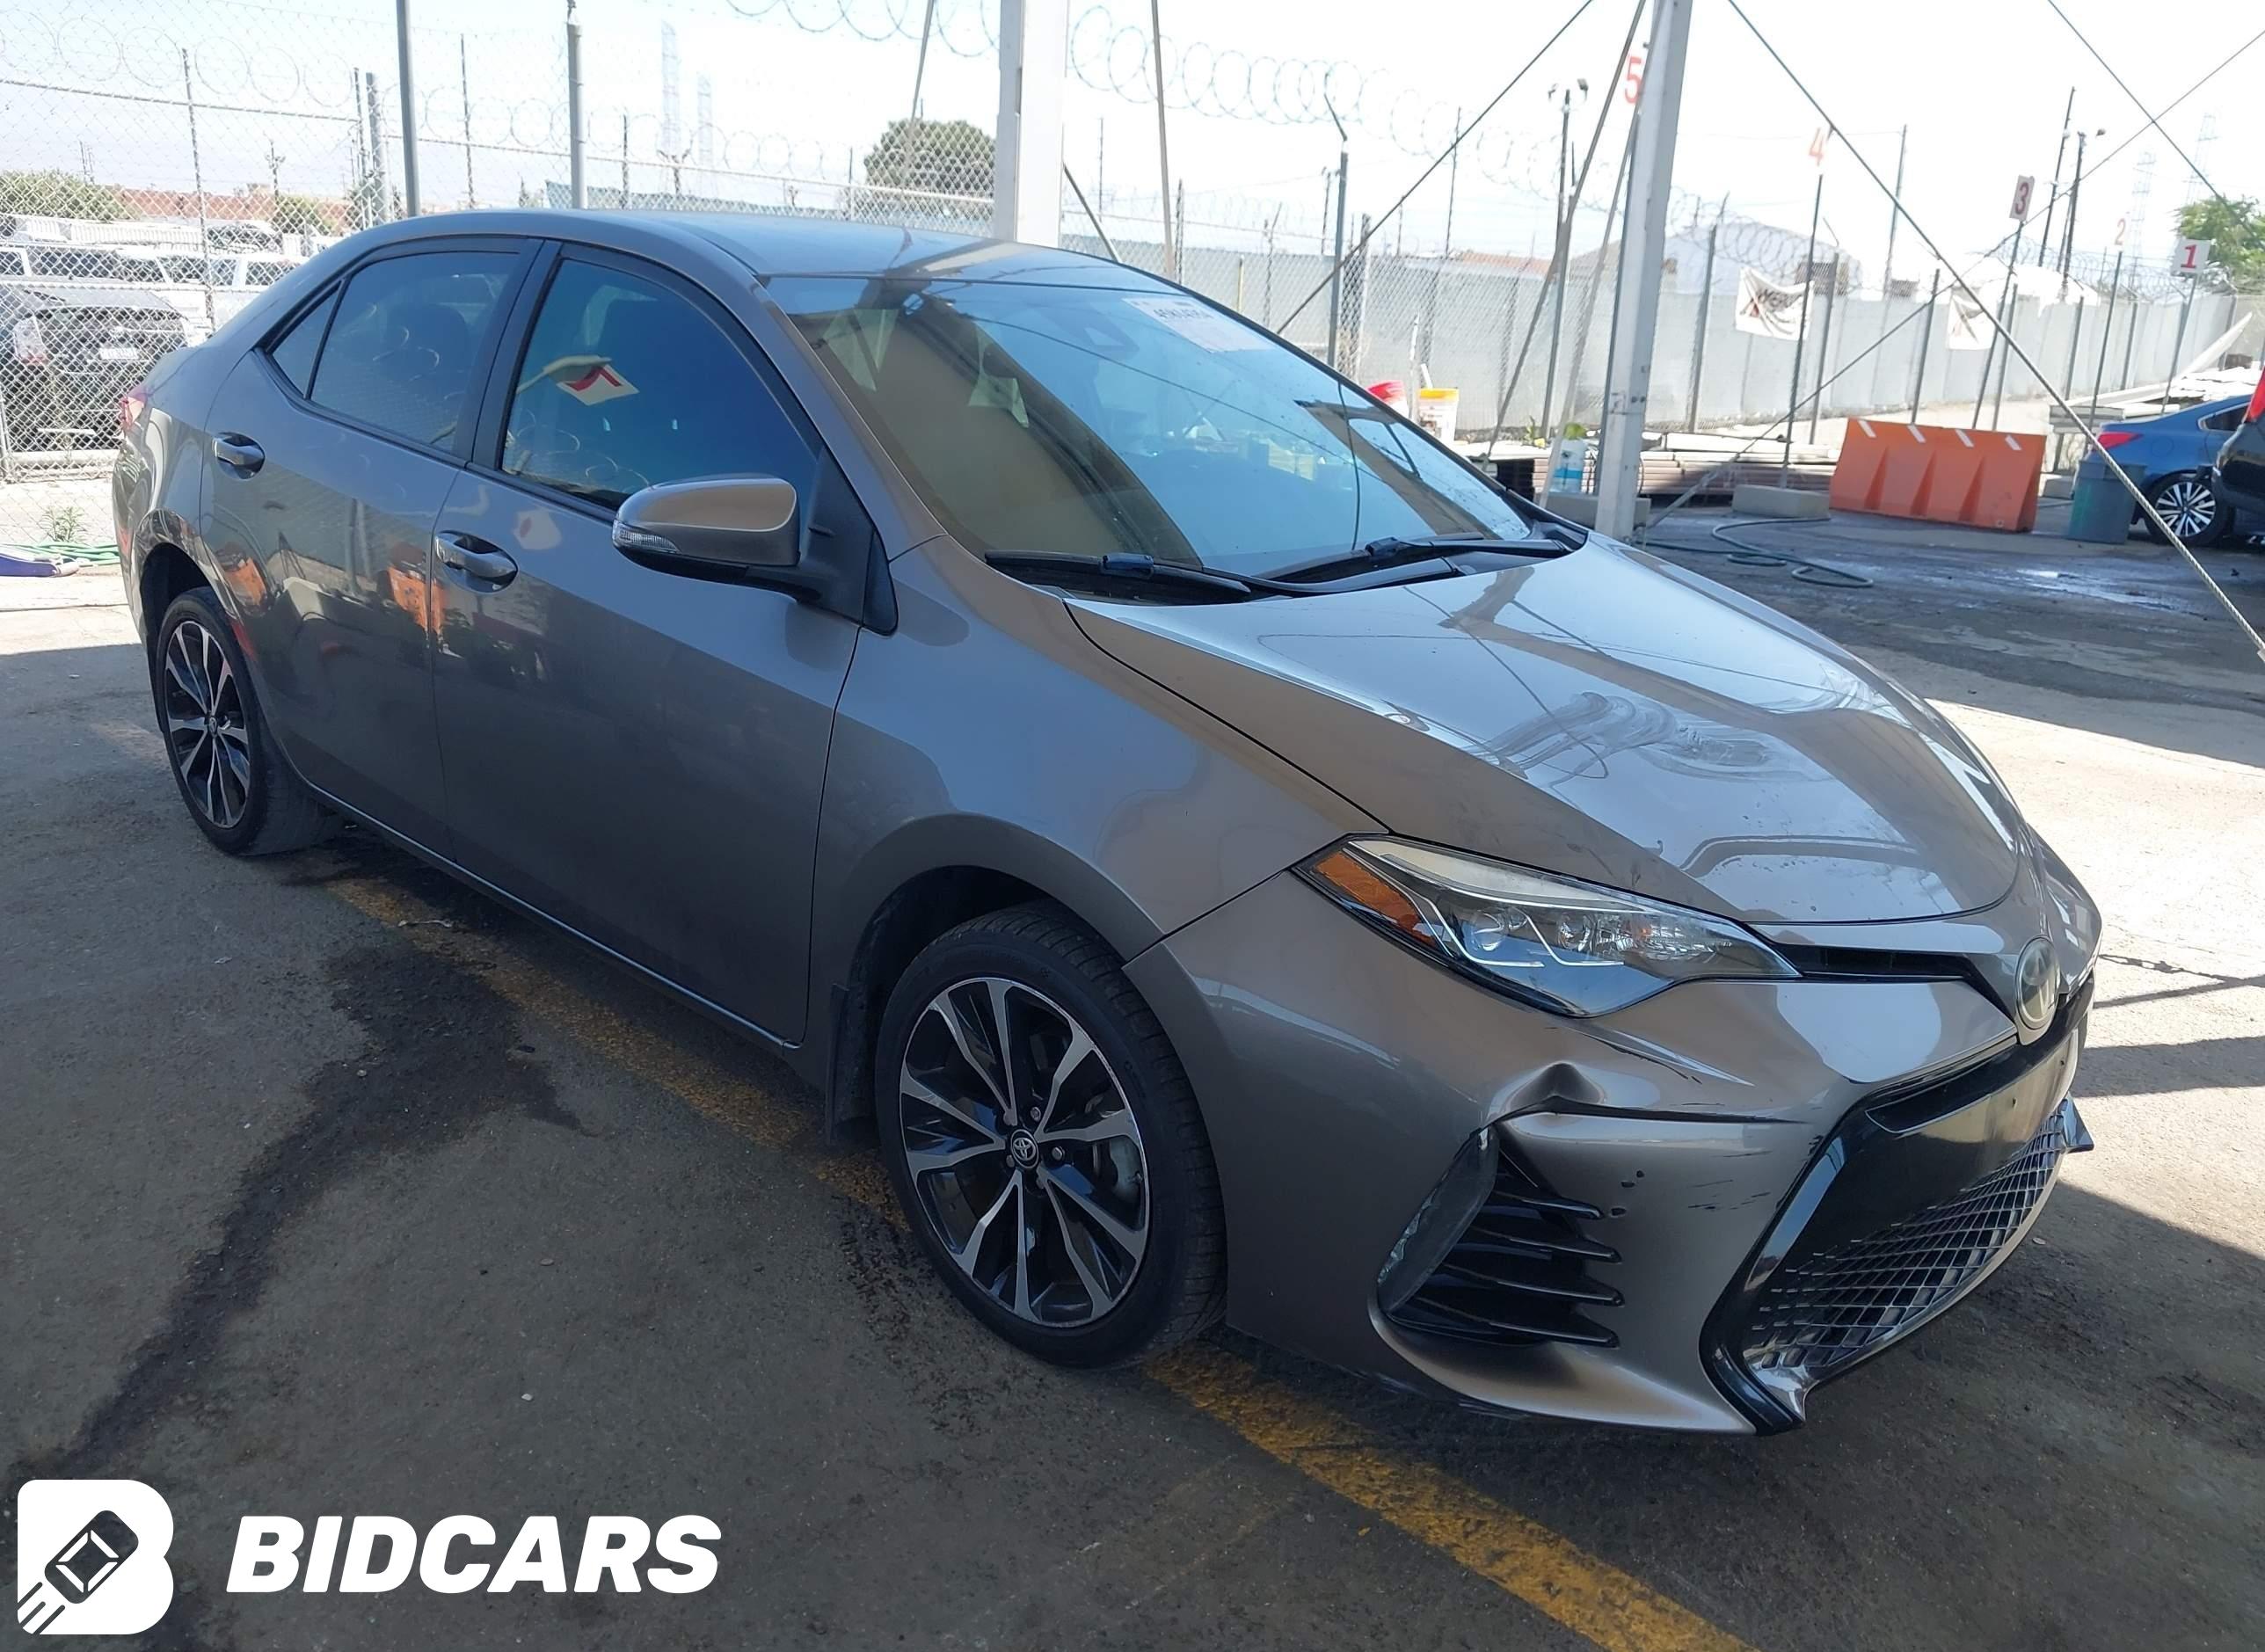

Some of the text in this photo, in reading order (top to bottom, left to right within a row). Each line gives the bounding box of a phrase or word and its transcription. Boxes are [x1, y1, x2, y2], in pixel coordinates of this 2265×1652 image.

[1624, 55, 1644, 104] 5
[1809, 127, 1824, 167] 4
[2014, 181, 2029, 215] 3
[2115, 217, 2126, 245] 2
[2181, 244, 2197, 268] 1
